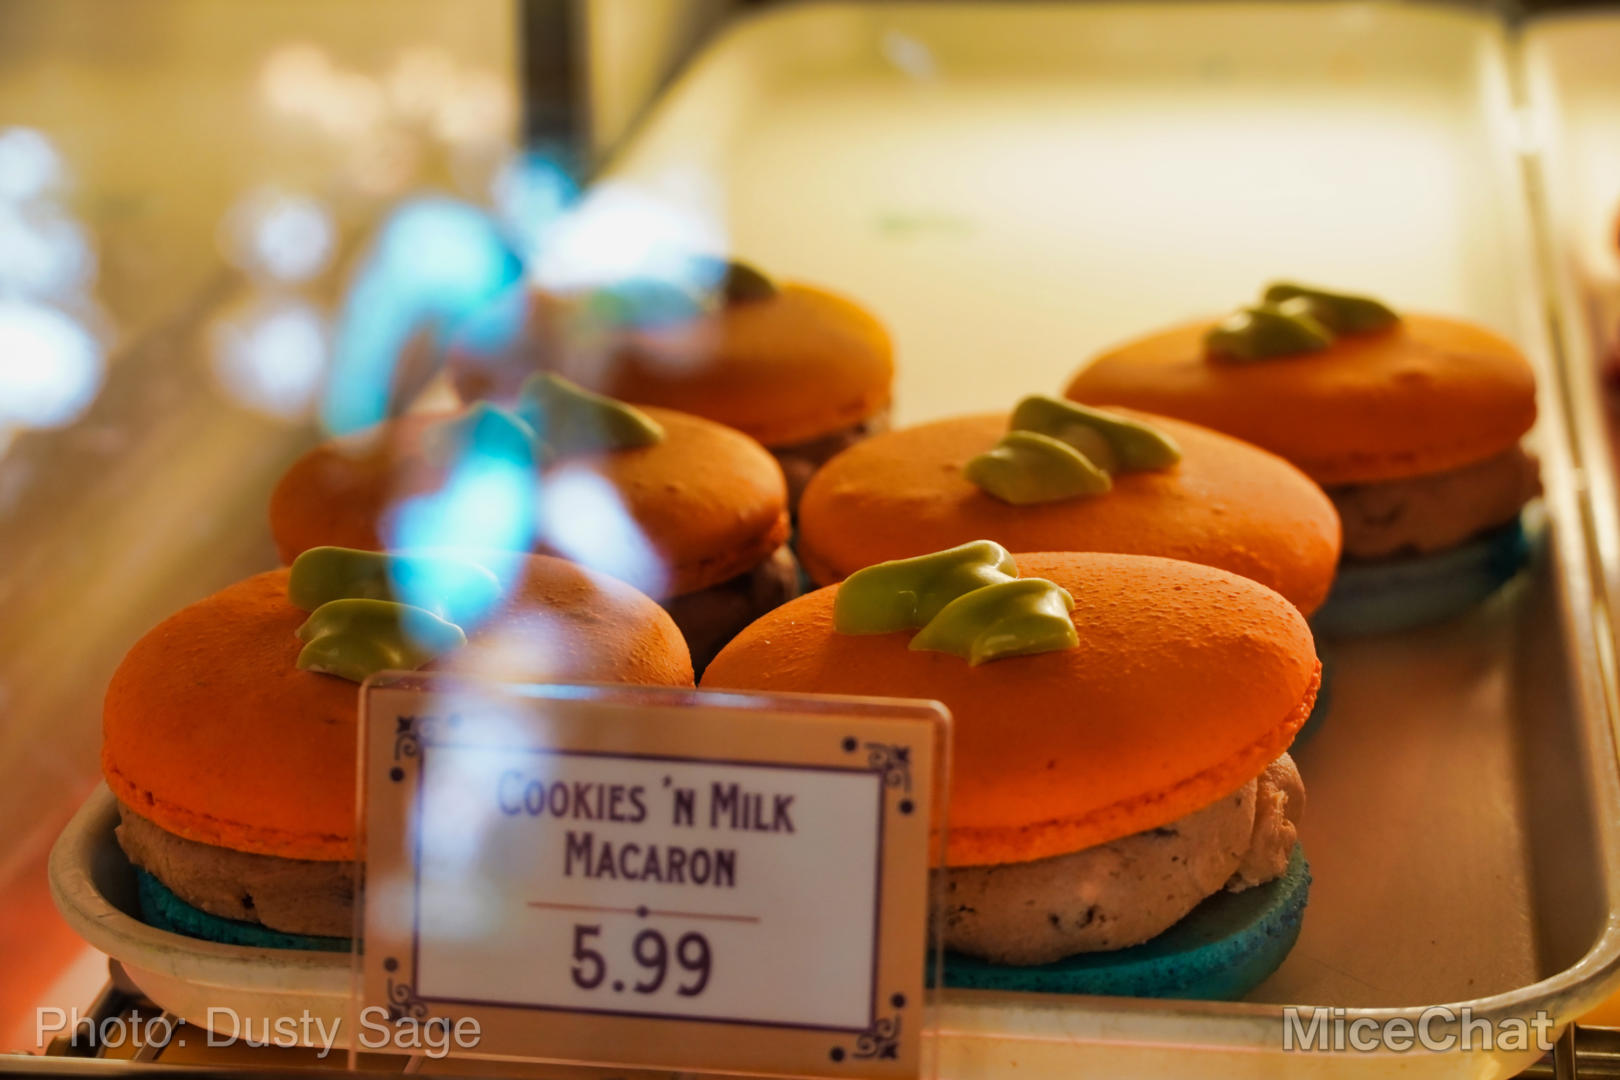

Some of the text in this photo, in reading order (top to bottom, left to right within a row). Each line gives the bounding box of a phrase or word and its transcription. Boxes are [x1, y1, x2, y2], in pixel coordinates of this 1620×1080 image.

[500, 771, 647, 824] COOKIES
[711, 782, 796, 833] MILK
[564, 832, 737, 888] MACARON
[571, 925, 713, 997] 5.99
